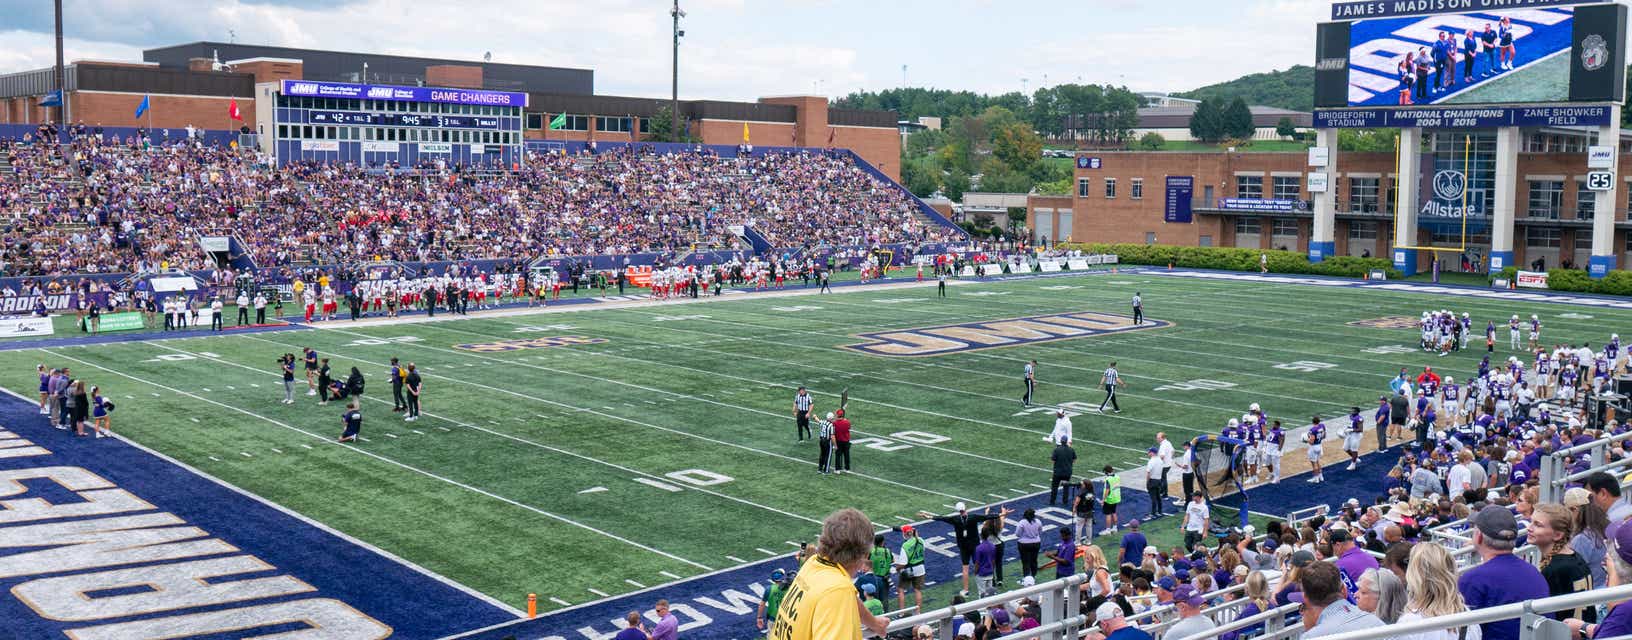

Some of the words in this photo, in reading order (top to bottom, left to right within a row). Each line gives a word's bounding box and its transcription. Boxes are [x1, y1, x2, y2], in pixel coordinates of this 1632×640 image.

[1336, 3, 1384, 16] JAMES
[1394, 0, 1471, 12] MADISON
[1316, 58, 1346, 70] JMU
[290, 83, 318, 94] JMU
[367, 88, 393, 98] JMU
[431, 91, 458, 102] GAME
[460, 92, 510, 104] CHANGERS
[332, 114, 343, 122] 42
[1318, 111, 1376, 120] BRIDGEFORTH
[1394, 110, 1442, 119] NATIONAL
[1444, 110, 1504, 118] CHAMPIONS
[1524, 108, 1550, 117] ZANE
[1552, 108, 1603, 116] SHOWKER
[402, 115, 420, 125] 9:45
[474, 118, 479, 127] 7
[1452, 118, 1476, 126] 2016
[1548, 116, 1577, 125] FIELD
[1591, 174, 1609, 187] 25
[1421, 200, 1476, 218] Allstate
[836, 312, 1176, 358] JMU
[1271, 360, 1340, 372] 50
[1153, 379, 1240, 391] 40
[848, 430, 952, 452] 20
[632, 468, 736, 493] 10
